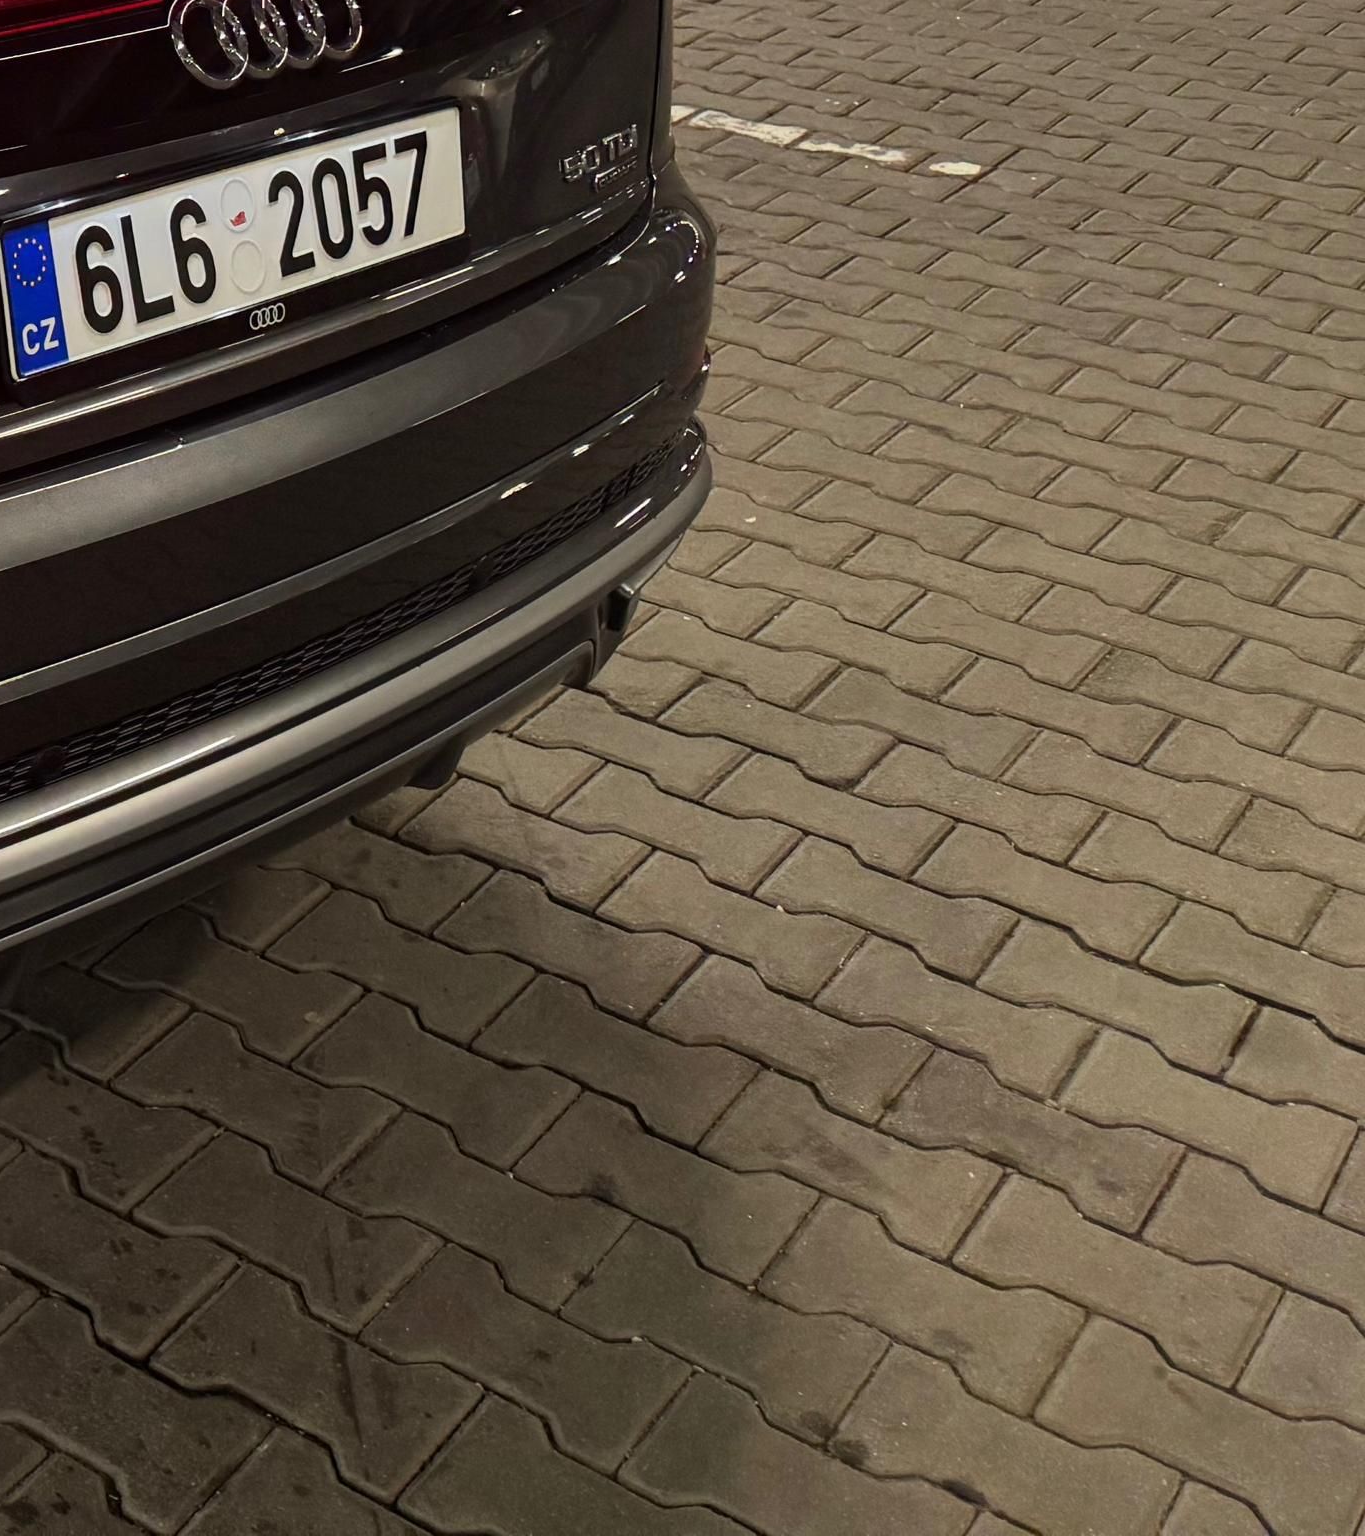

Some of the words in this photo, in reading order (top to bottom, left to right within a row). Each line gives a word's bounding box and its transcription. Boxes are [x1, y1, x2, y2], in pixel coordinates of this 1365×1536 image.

[74, 196, 217, 336] 6L6
[267, 130, 429, 279] 2057
[21, 313, 60, 357] CZ
